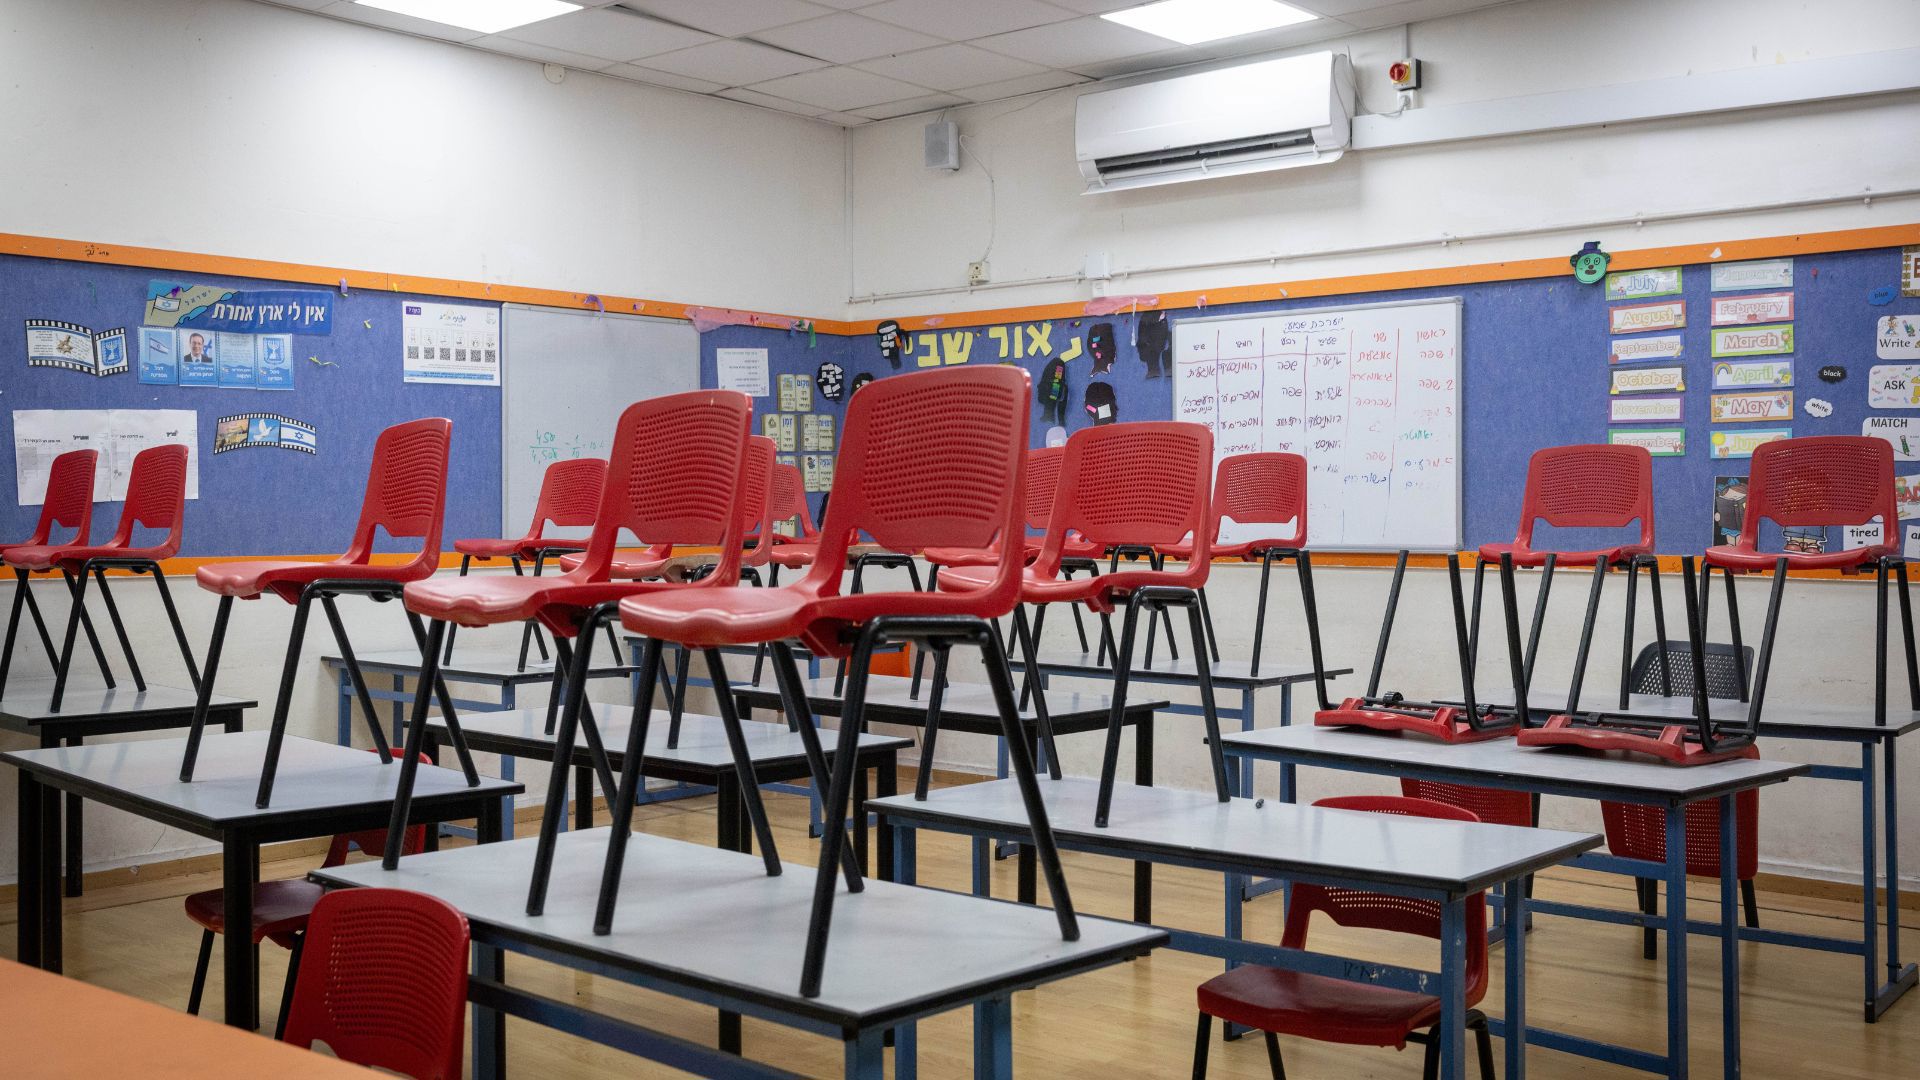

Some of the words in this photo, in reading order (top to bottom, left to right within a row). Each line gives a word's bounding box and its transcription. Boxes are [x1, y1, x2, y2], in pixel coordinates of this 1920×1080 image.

[1627, 274, 1660, 293] July
[212, 303, 254, 321] אחרת
[288, 301, 301, 321] לי
[1721, 299, 1783, 315] February
[259, 305, 283, 325] ארץ
[305, 305, 325, 325] אין
[1622, 306, 1674, 326] August
[1373, 331, 1387, 342] שני
[1416, 328, 1446, 343] ראשון
[1724, 332, 1778, 349] March
[1614, 341, 1680, 356] September
[1880, 338, 1911, 348] Write
[1420, 350, 1444, 359] שפה
[1277, 361, 1298, 371] שפה
[1617, 372, 1678, 387] October
[1733, 365, 1773, 383] April
[1281, 386, 1302, 397] שפה
[1418, 379, 1440, 391] שפה
[1884, 380, 1906, 390] ASK
[1231, 390, 1260, 404] מספרים
[1614, 402, 1679, 415] November
[1731, 398, 1772, 417] May
[1812, 402, 1829, 412] white
[1228, 416, 1259, 430] מספרים
[1871, 418, 1908, 429] MATCH
[1849, 527, 1879, 537] tired
